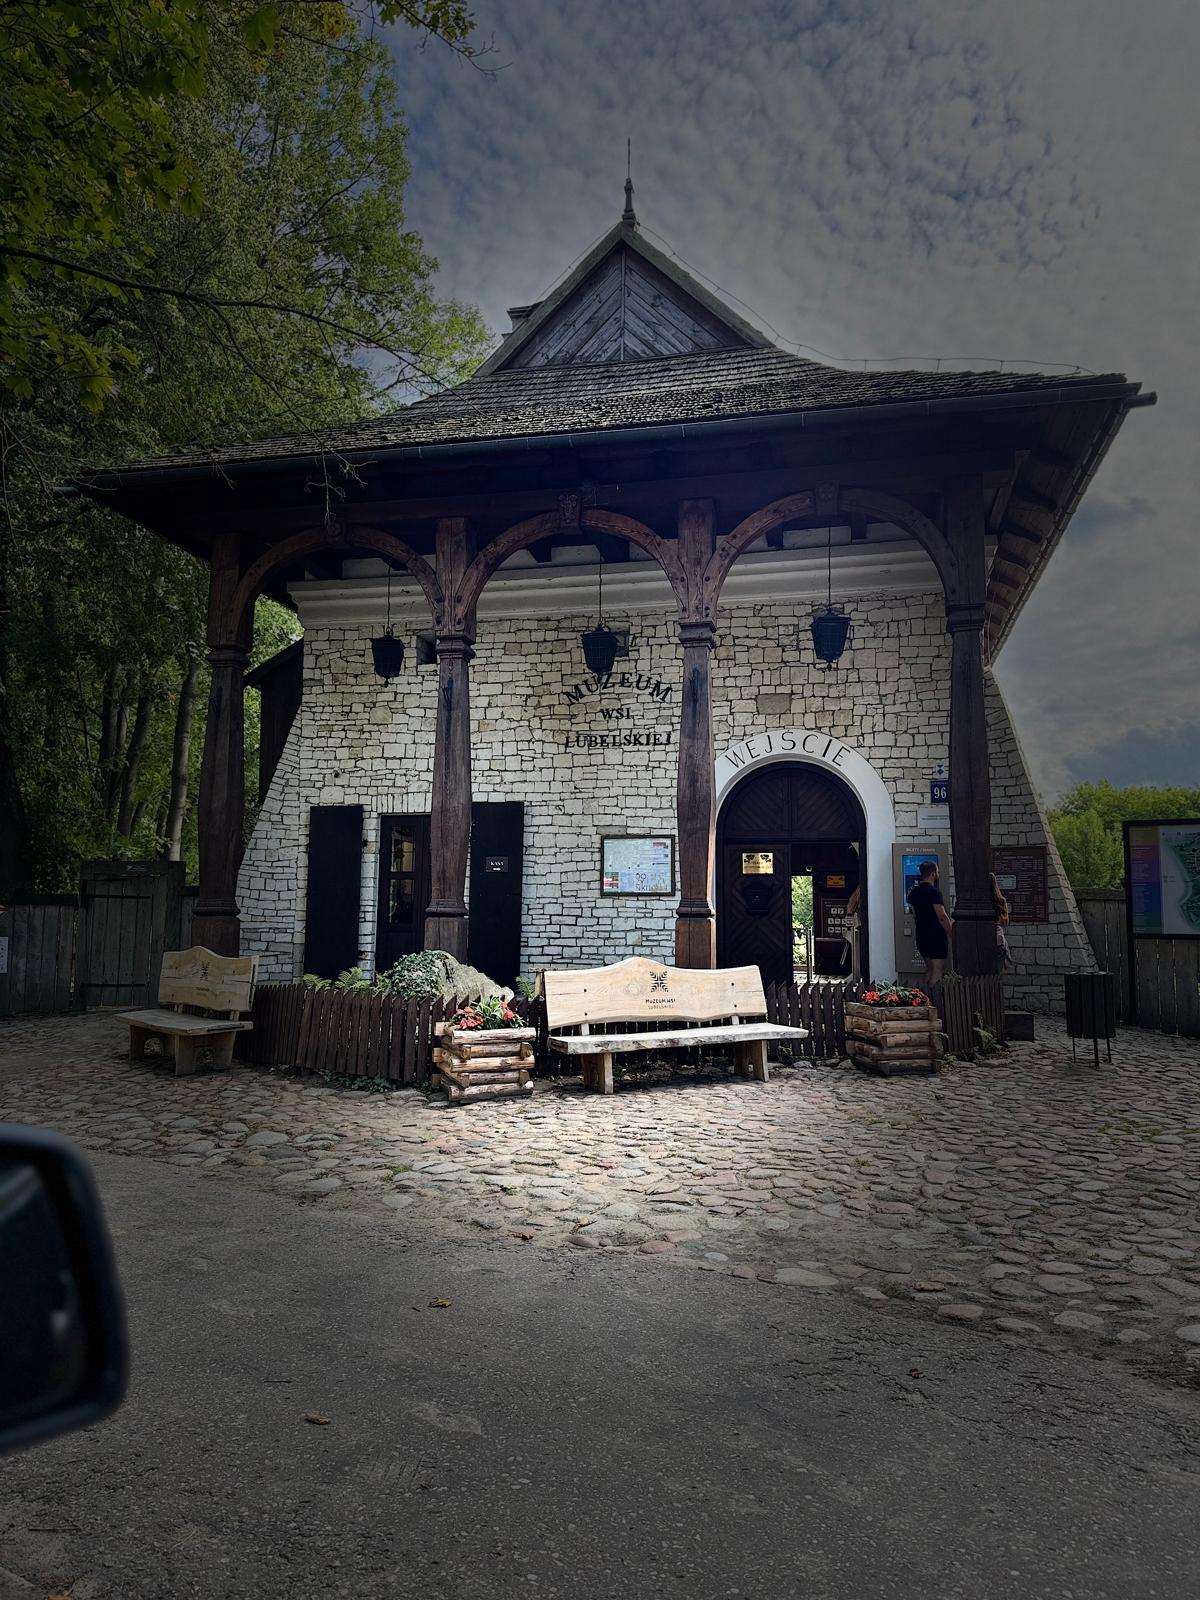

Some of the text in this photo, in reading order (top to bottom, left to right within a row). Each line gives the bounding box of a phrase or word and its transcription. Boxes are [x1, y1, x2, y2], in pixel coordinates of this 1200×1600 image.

[565, 672, 673, 702] MUZEUM
[600, 707, 631, 720] WSI
[565, 731, 672, 748] LUBELSKIEJ
[933, 786, 947, 799] 96
